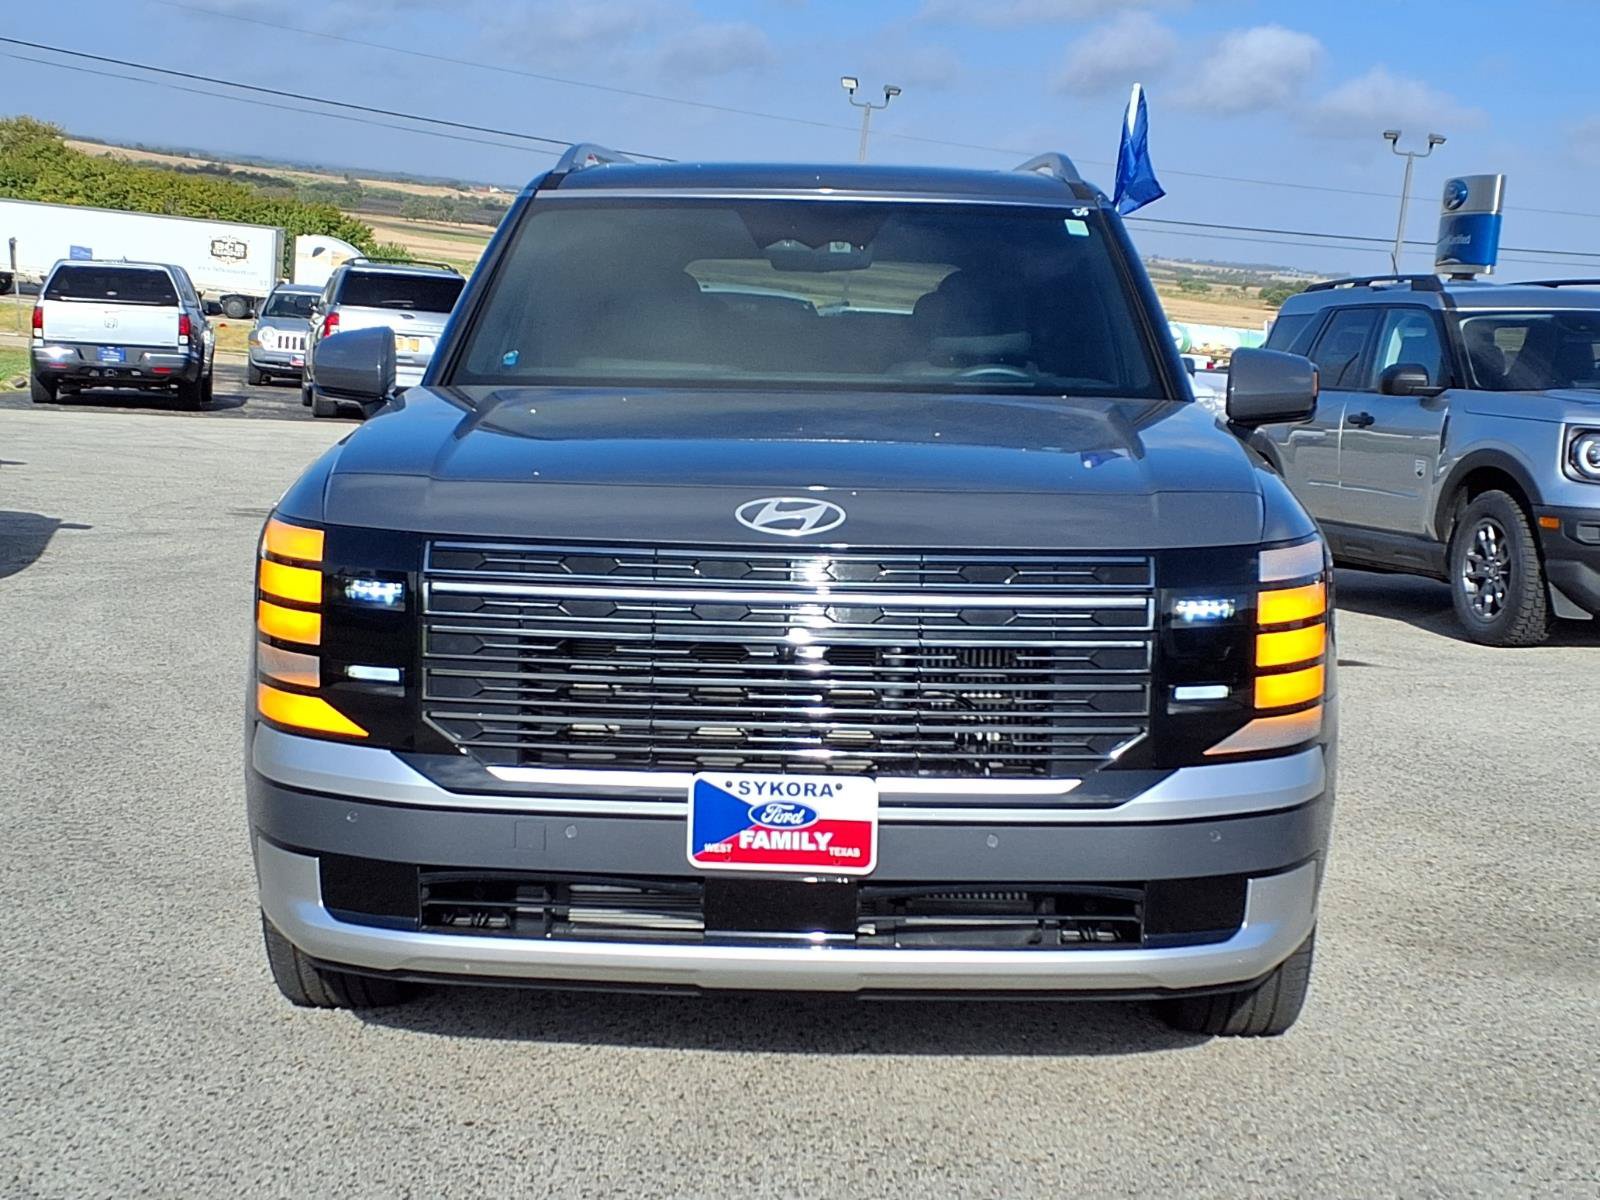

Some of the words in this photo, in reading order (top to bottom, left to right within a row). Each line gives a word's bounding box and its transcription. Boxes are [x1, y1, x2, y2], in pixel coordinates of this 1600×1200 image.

[738, 780, 834, 797] SYKORA
[761, 803, 804, 824] Ford
[704, 843, 733, 854] WEST
[738, 830, 834, 851] FAMILY
[829, 846, 861, 857] TEXAS
